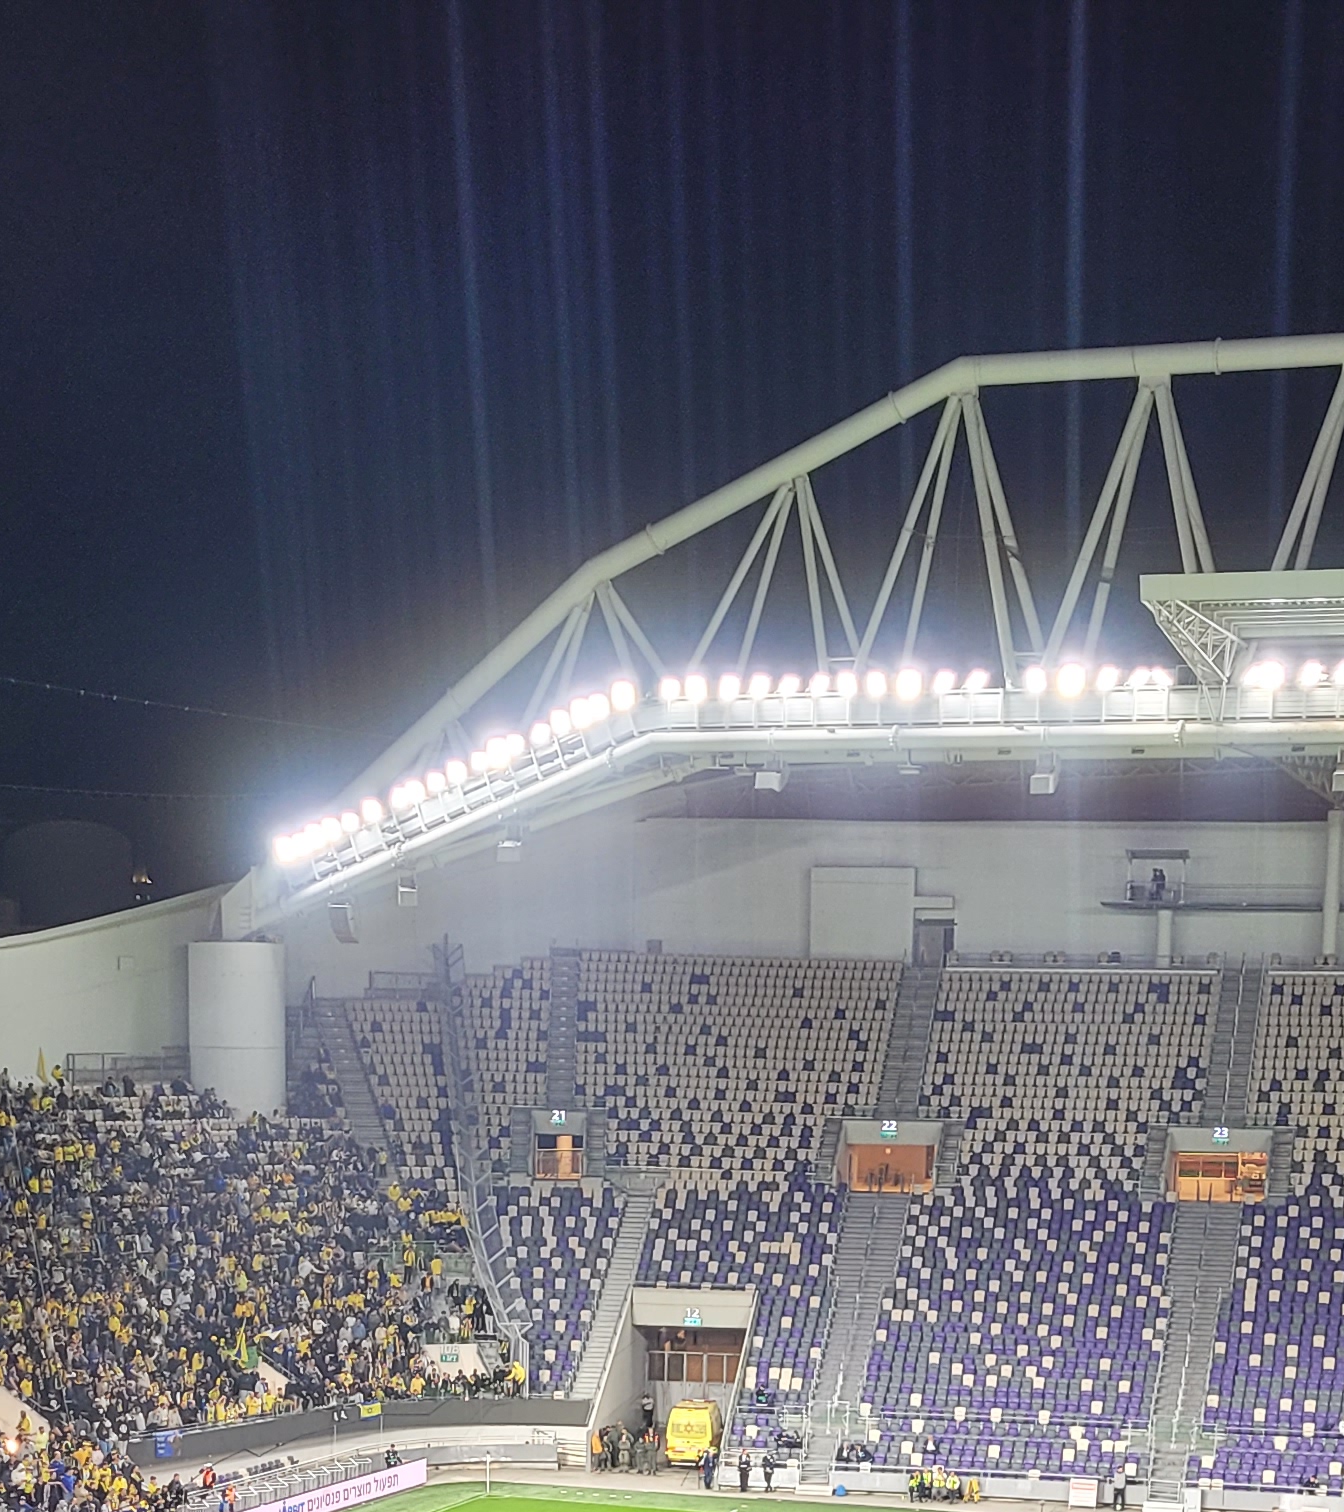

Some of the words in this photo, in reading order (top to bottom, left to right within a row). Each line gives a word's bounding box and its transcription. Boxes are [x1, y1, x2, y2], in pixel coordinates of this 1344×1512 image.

[551, 1110, 566, 1121] 21
[881, 1120, 898, 1131] 22
[1213, 1127, 1229, 1138] 23
[685, 1307, 700, 1319] 12
